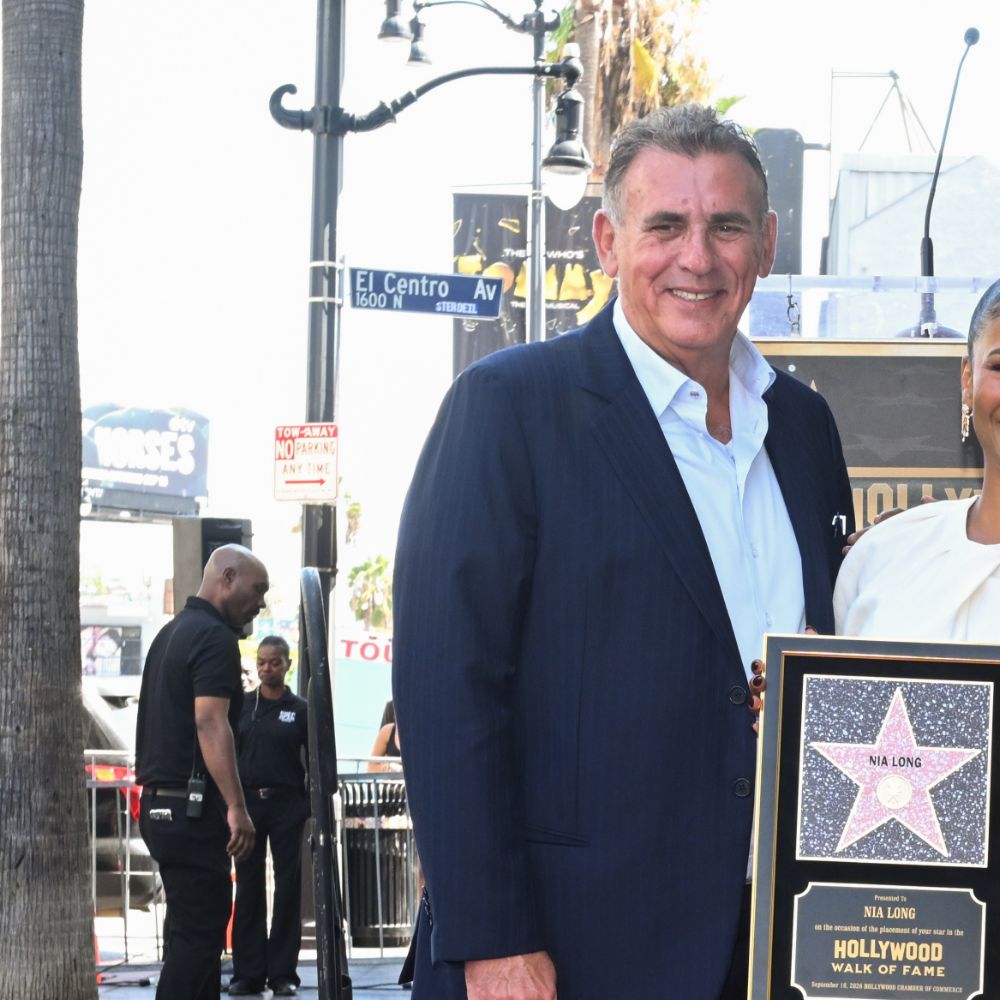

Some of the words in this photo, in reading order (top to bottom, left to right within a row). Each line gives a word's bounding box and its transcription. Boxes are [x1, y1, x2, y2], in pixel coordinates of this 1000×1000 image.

[547, 250, 585, 260] WHO'S
[356, 271, 374, 293] El
[384, 272, 449, 298] Centro
[474, 279, 497, 301] Av
[356, 293, 387, 308] 1600
[393, 295, 403, 309] N
[277, 426, 335, 438] TOW-AWAY
[275, 440, 294, 459] NO
[296, 441, 336, 456] PARKING
[283, 463, 303, 475] ANY
[308, 462, 330, 475] TIME
[869, 755, 889, 767] NIA
[892, 756, 922, 768] LONG
[874, 894, 900, 902] Presented
[863, 905, 884, 918] NIA
[887, 906, 916, 920] LONG
[823, 923, 833, 931] the
[879, 925, 910, 935] placement
[918, 928, 932, 936] your
[932, 928, 946, 936] star
[946, 928, 953, 936] in
[954, 929, 964, 937] the
[834, 938, 943, 962] HOLLYWOOD
[831, 962, 873, 975] WALK
[878, 964, 897, 976] OF
[902, 965, 946, 978] FAME
[811, 981, 839, 989] September
[863, 983, 896, 991] HOLLYWOOD
[896, 984, 924, 992] CHAMBER
[924, 984, 932, 992] OF
[932, 985, 963, 993] COMMERCE
